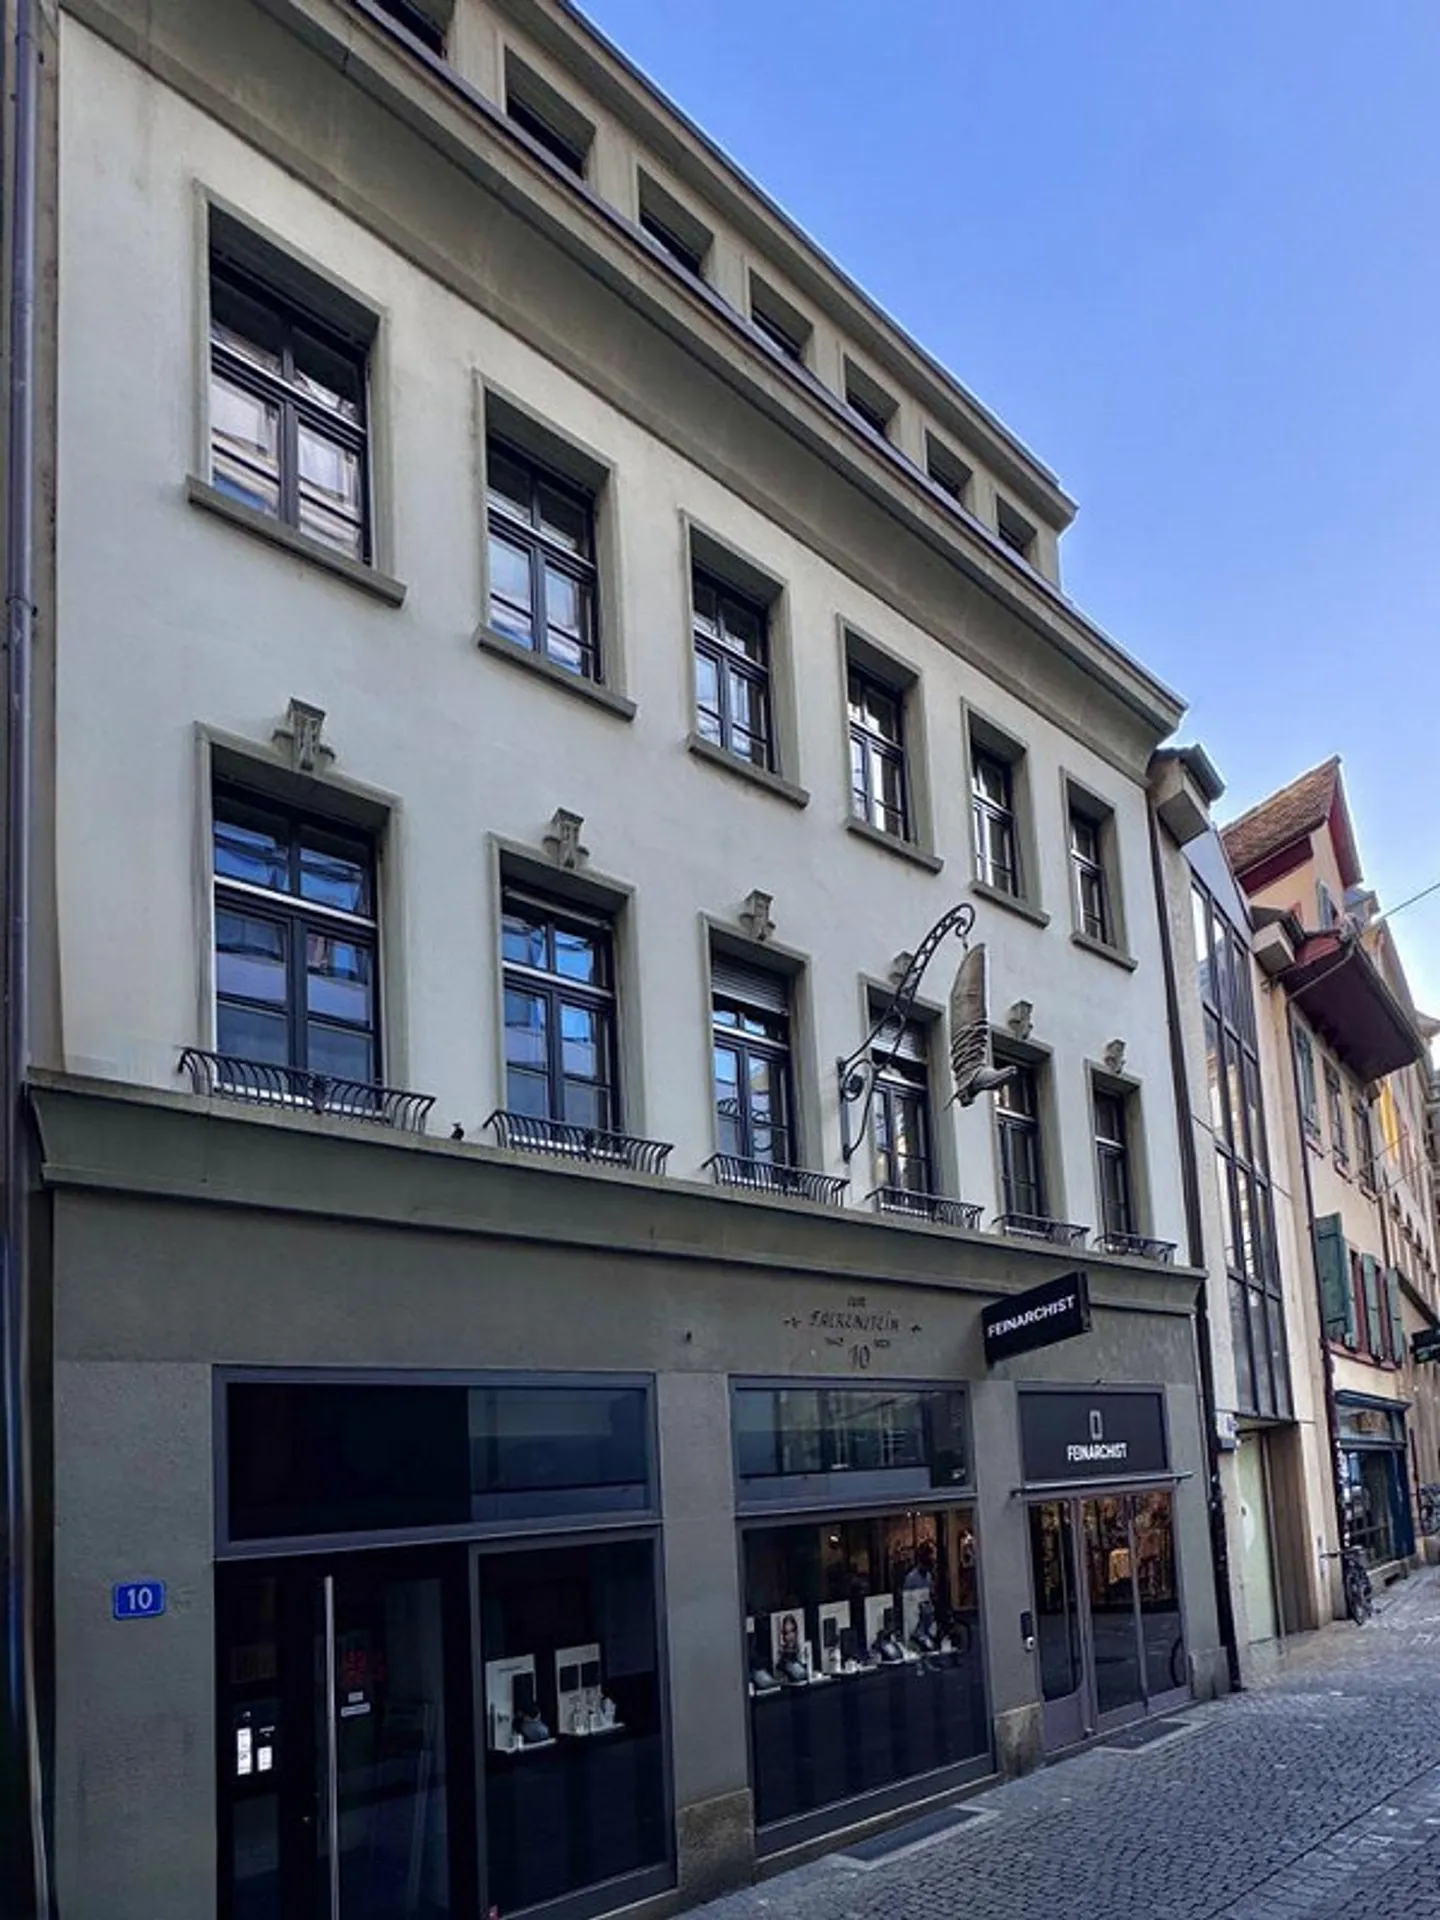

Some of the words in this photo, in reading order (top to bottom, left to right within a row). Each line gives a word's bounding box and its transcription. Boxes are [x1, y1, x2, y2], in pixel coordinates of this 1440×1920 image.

[987, 1294, 1076, 1338] FEINARCHIST
[848, 1344, 870, 1369] 10
[1067, 1442, 1128, 1461] FEINARCHIST
[127, 1587, 153, 1610] 10
